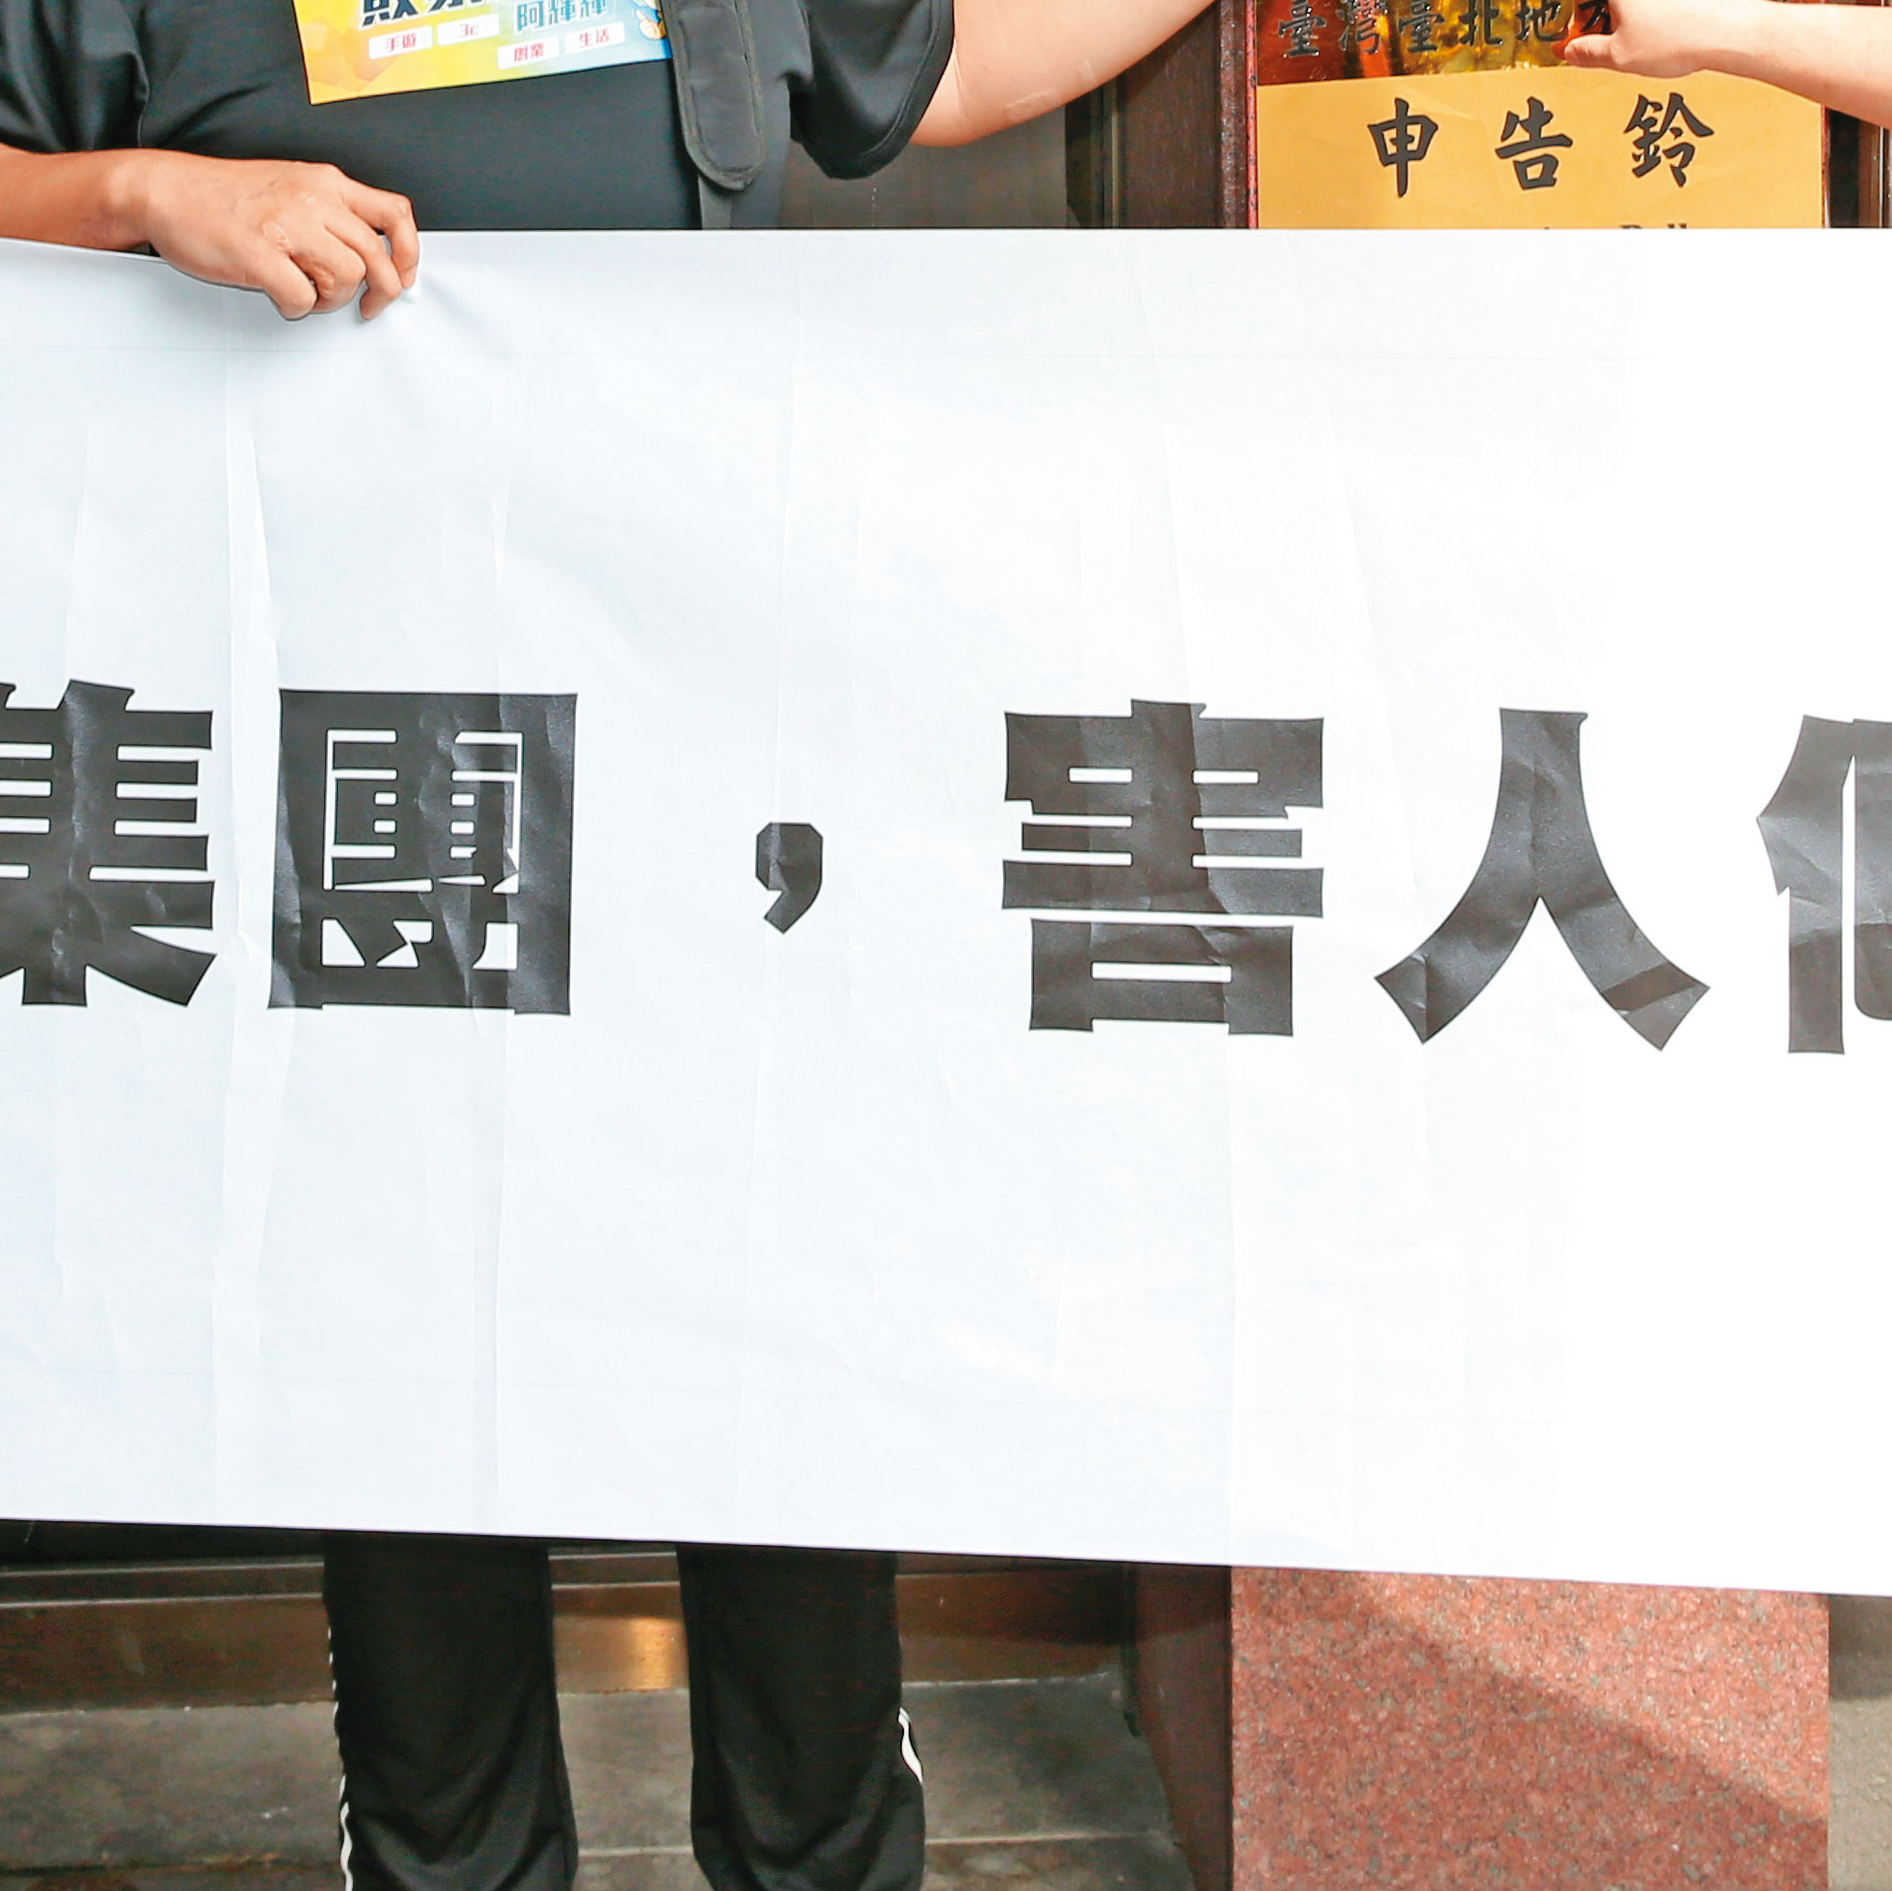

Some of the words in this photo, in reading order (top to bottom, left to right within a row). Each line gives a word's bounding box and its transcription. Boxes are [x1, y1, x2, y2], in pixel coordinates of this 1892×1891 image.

[385, 33, 417, 53] 手遊
[579, 29, 610, 49] 生活
[1367, 91, 1714, 199] 申告鈴
